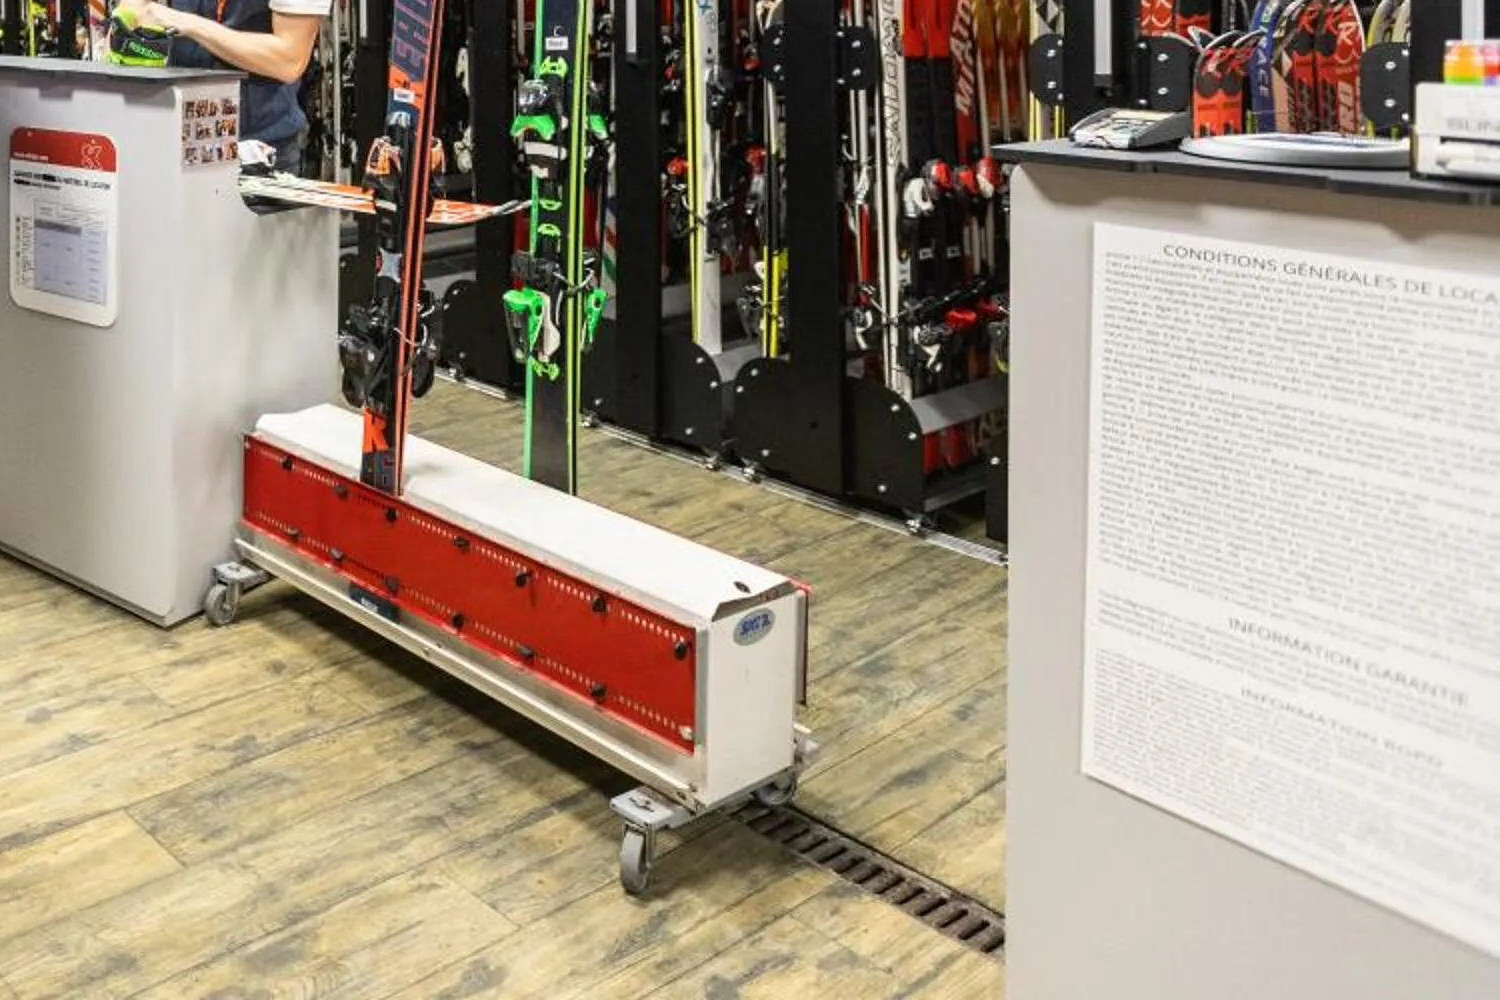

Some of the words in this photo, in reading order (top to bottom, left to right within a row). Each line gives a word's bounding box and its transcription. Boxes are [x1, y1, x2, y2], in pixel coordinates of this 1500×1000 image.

[1163, 243, 1278, 273] CONDITIONS
[1283, 259, 1398, 291] GÉNÉRALES
[1404, 279, 1431, 296] DE
[1229, 617, 1360, 672] INFORMATION
